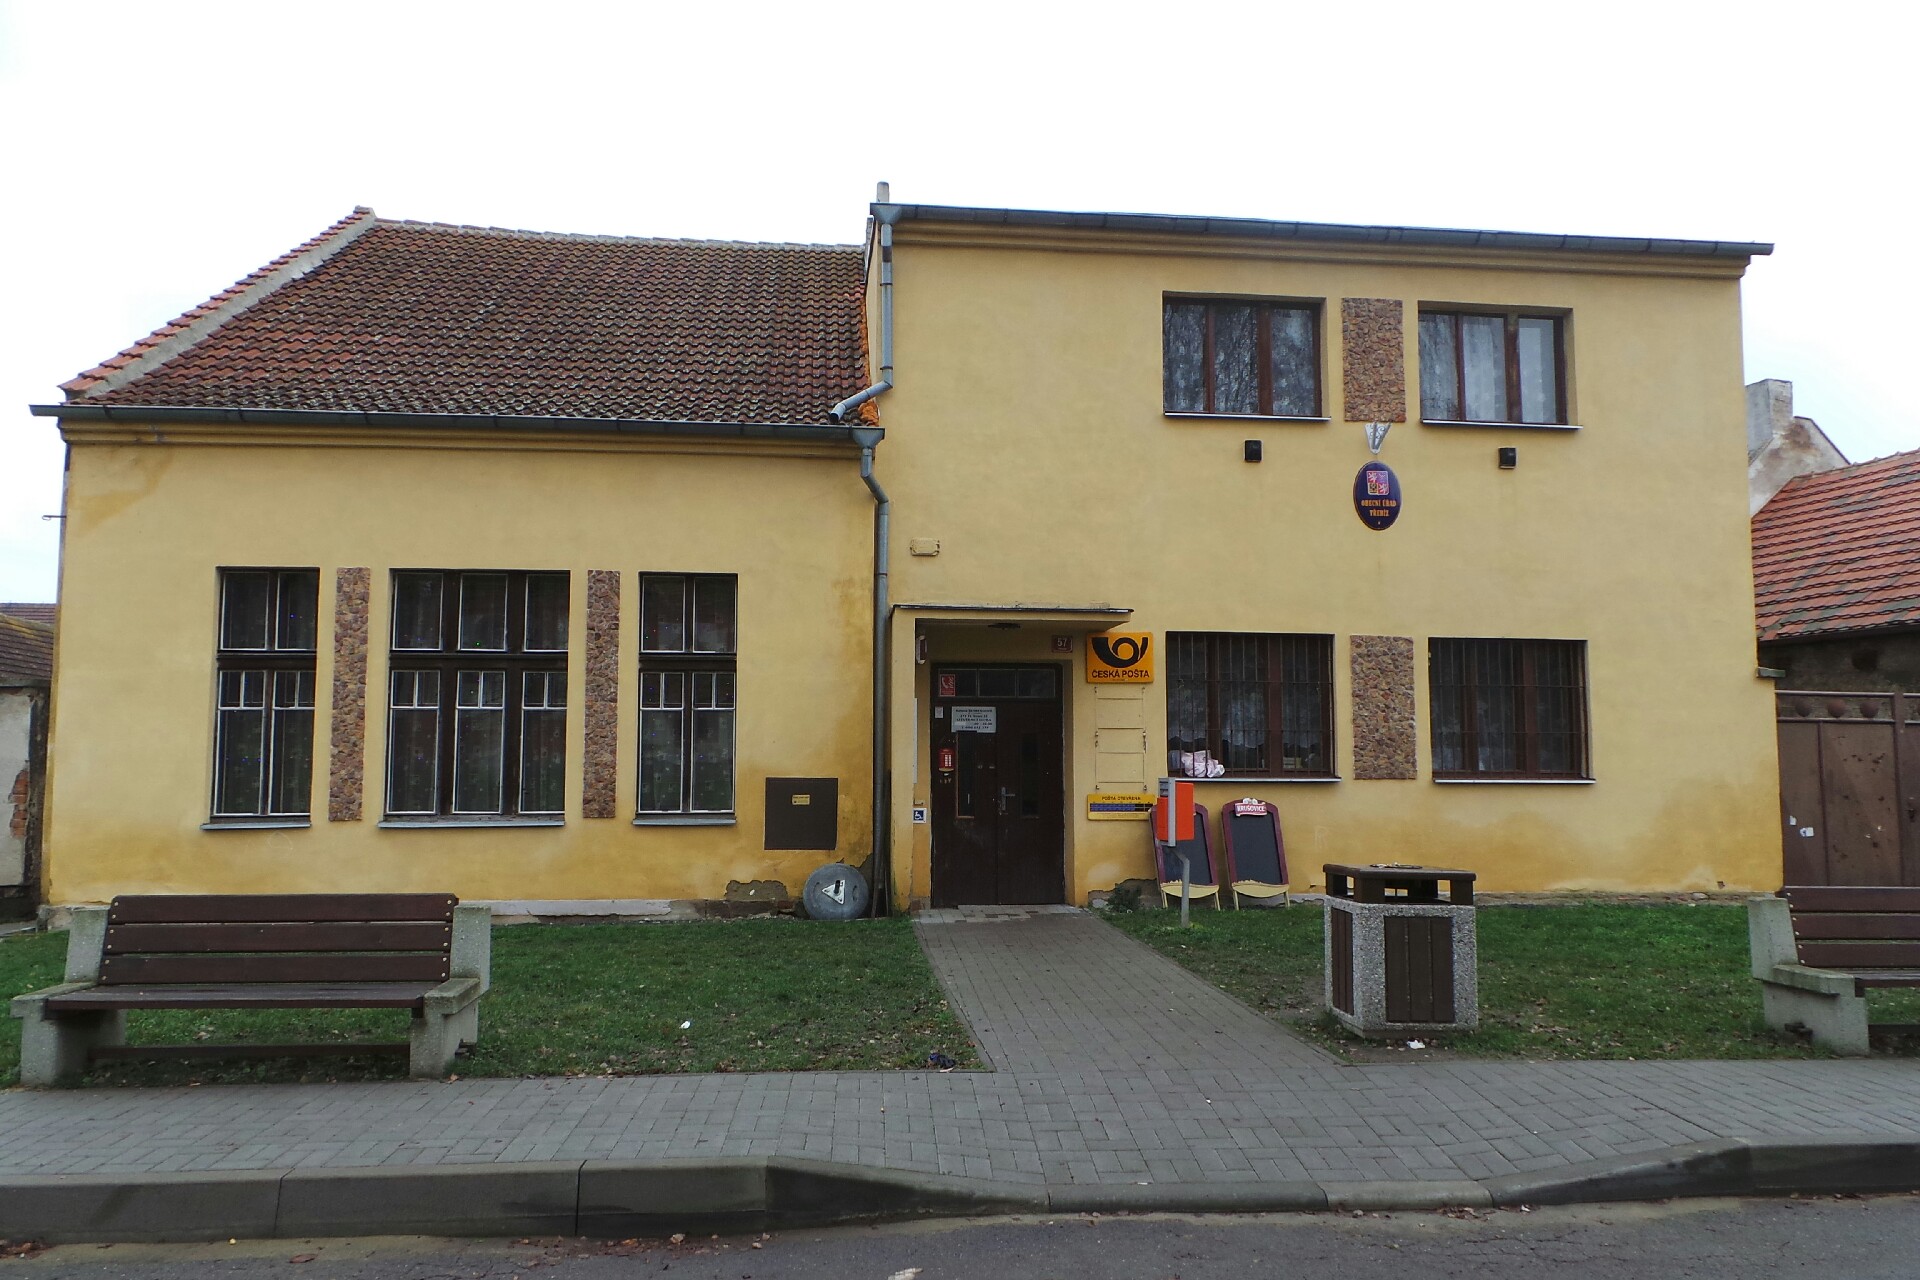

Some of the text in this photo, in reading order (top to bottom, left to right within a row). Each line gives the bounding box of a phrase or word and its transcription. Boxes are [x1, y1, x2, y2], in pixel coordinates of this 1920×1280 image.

[1057, 638, 1067, 647] 57
[1092, 669, 1150, 678] ČESKÁ POŠTA
